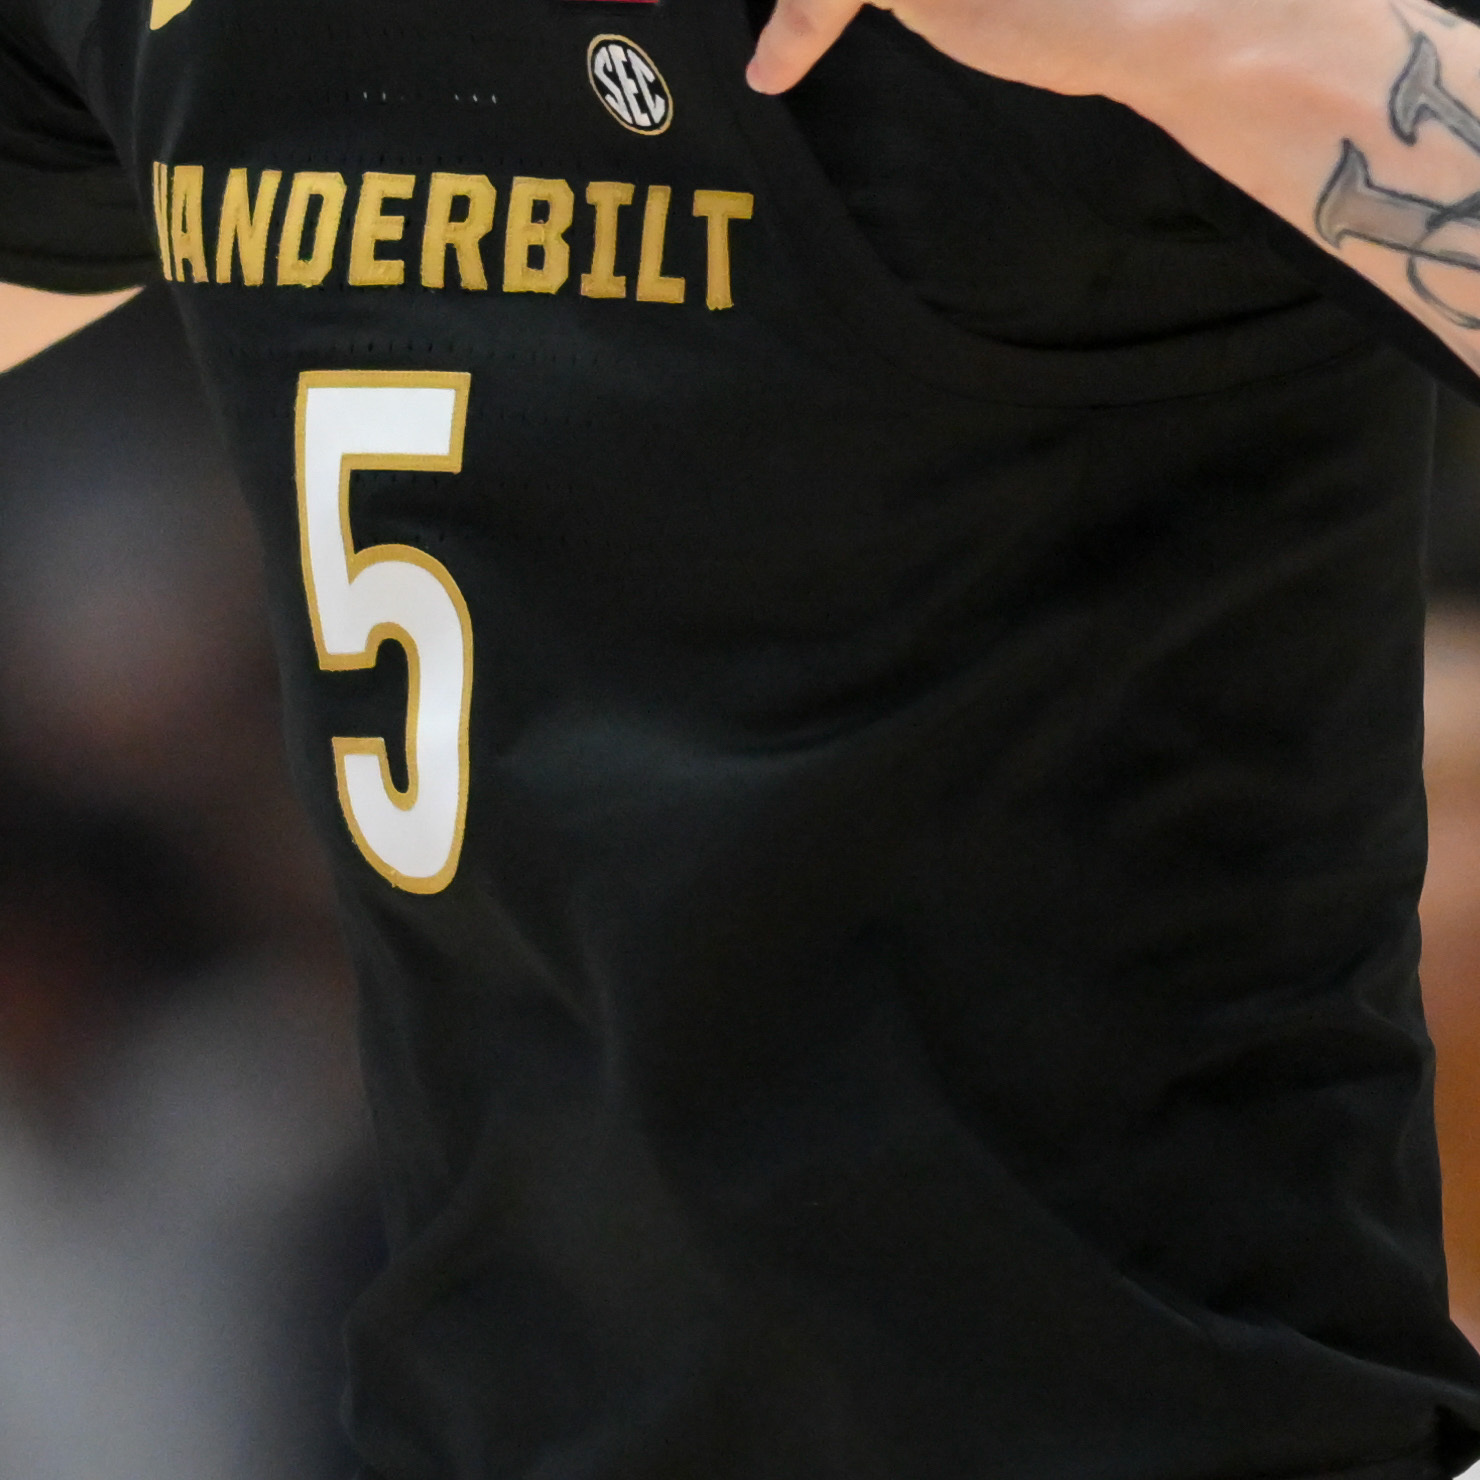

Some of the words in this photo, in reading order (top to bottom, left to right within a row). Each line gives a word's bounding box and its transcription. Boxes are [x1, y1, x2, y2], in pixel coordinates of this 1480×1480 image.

[594, 43, 666, 127] SEC
[152, 161, 754, 311] VANDERBILT
[294, 370, 473, 895] 5
